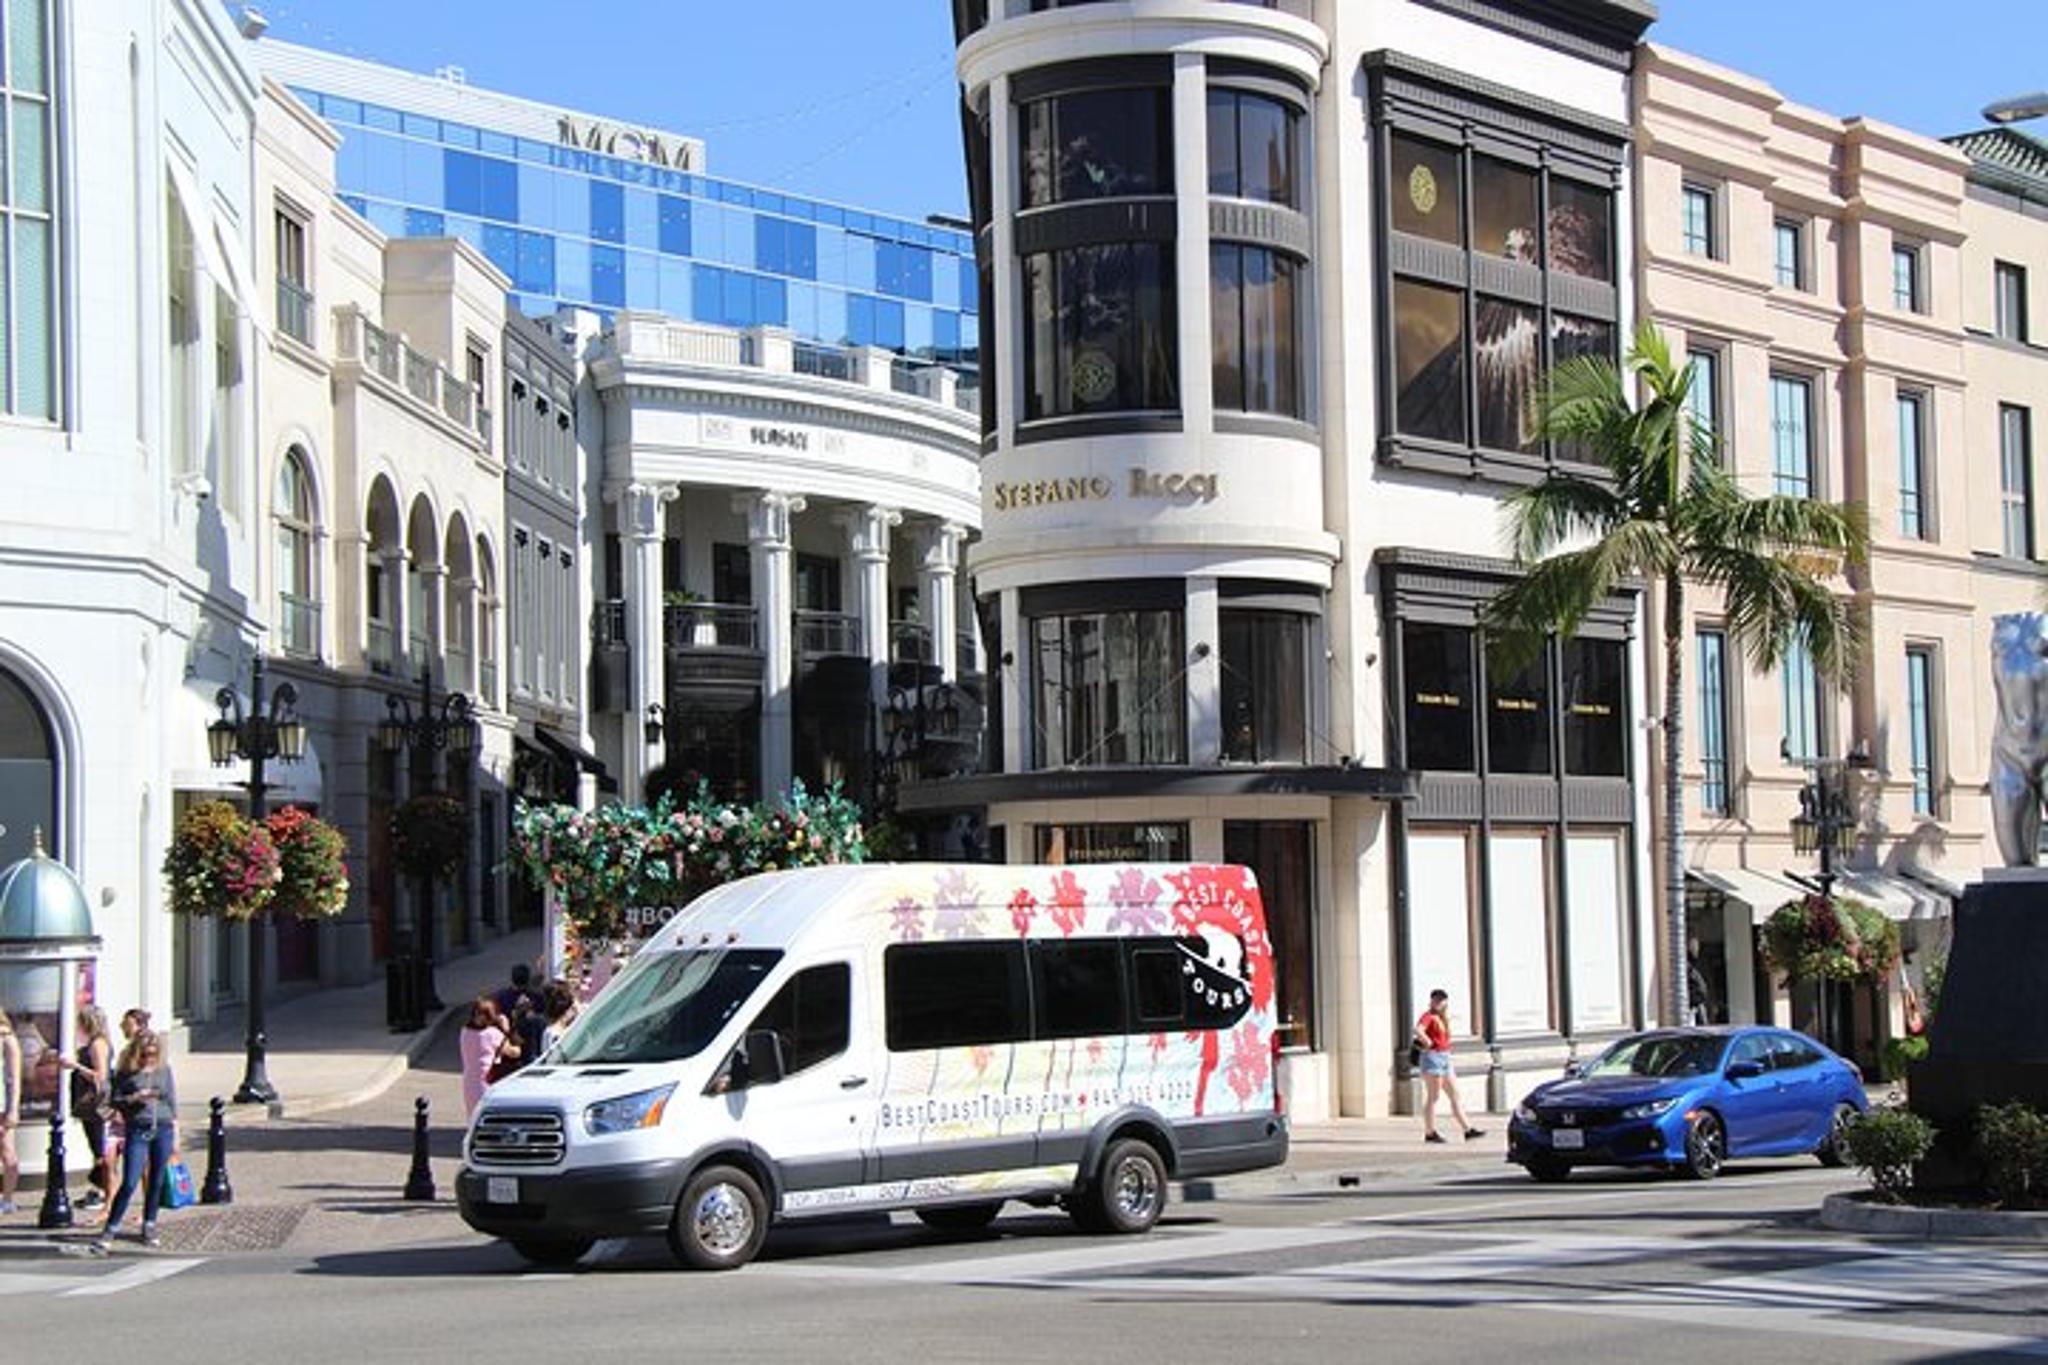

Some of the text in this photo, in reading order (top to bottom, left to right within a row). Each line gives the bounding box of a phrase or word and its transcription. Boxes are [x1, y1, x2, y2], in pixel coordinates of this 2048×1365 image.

[557, 115, 690, 171] MGM
[994, 476, 1112, 510] STEFANO
[625, 905, 682, 925] #BO
[1179, 882, 1261, 956] BEST COAST
[1182, 959, 1245, 1008] TOURS
